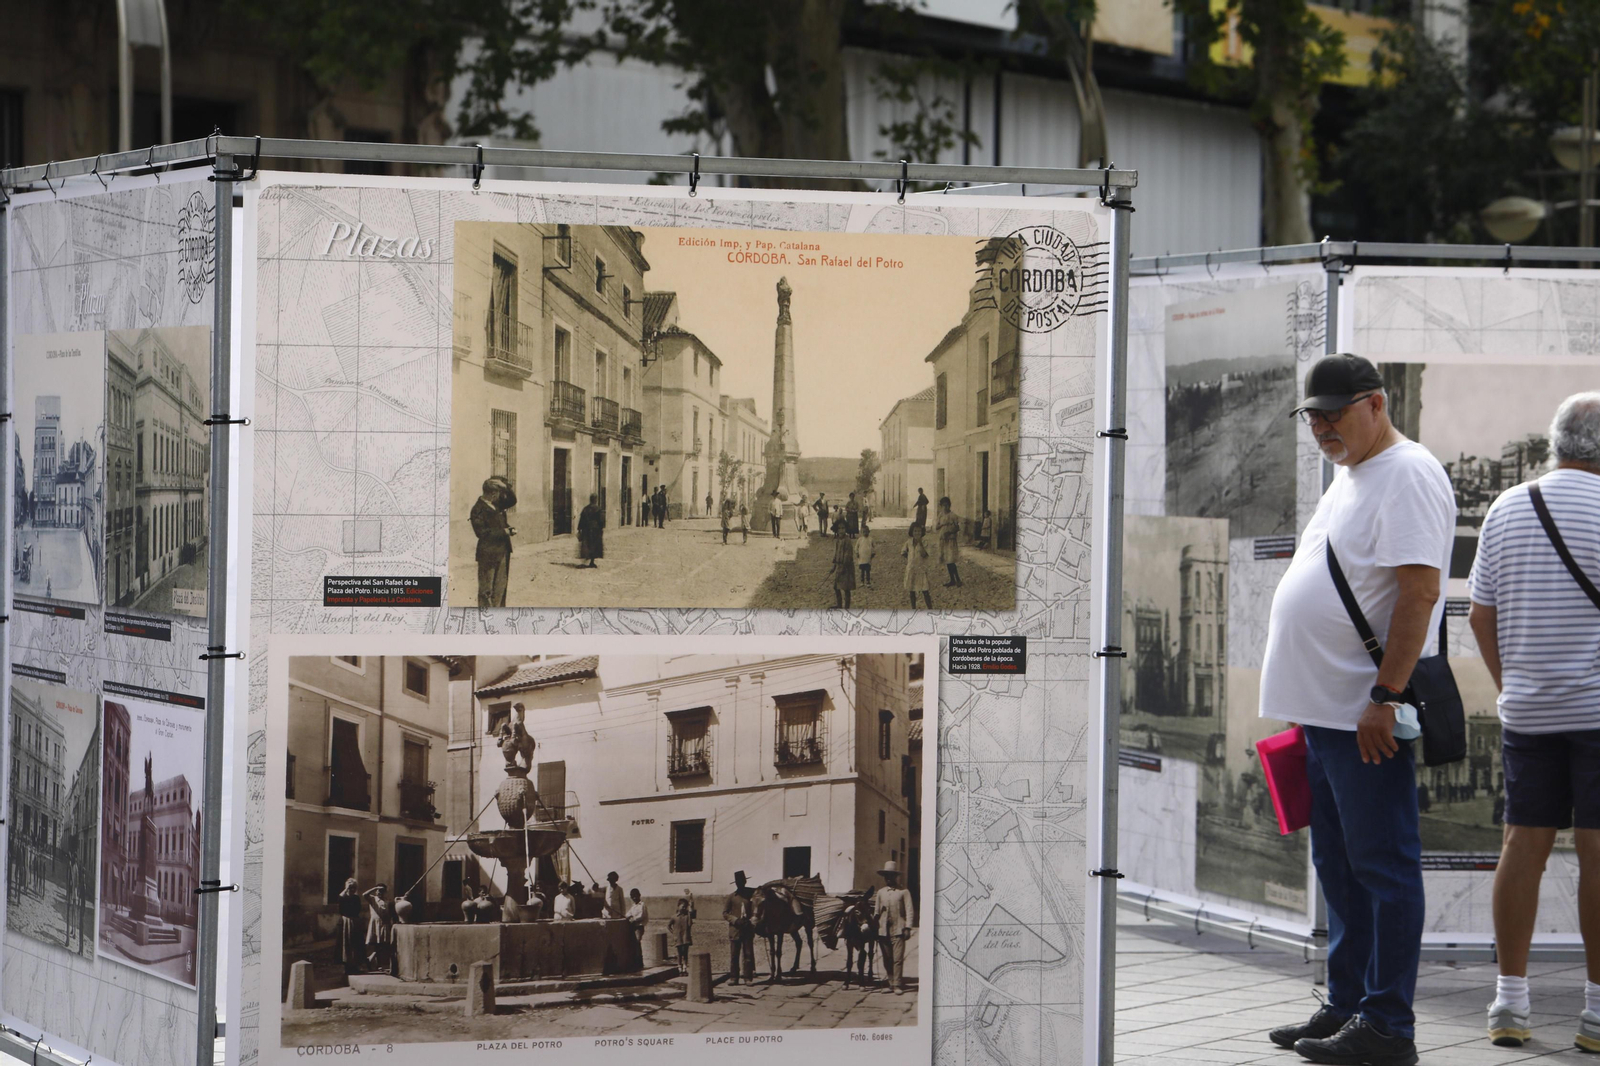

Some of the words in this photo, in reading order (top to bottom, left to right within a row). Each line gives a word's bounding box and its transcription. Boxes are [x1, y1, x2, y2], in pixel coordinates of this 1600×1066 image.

[318, 221, 438, 260] Plazas
[678, 236, 716, 248] Edición
[720, 238, 742, 250] Imp.
[746, 242, 752, 251] y
[755, 240, 776, 251] Pap.
[780, 241, 820, 251] Catalana
[1000, 233, 1029, 260] UNA
[1034, 229, 1076, 262] CIUDAD
[797, 254, 817, 266] San
[820, 255, 852, 267] Rafael
[856, 256, 872, 268] del
[876, 256, 904, 269] Potro
[1003, 299, 1022, 322] DE
[1026, 299, 1075, 328] POSTAL
[327, 578, 361, 586] Perspectiva
[327, 596, 354, 604] Imprenta
[706, 1036, 735, 1044] PLACE
[738, 1036, 750, 1044] DU
[753, 1035, 783, 1043] POTRO
[850, 1033, 869, 1041] Foto.
[477, 1042, 508, 1050] PLAZA
[510, 1042, 529, 1050] DEL
[532, 1041, 562, 1049] POTRO
[594, 1037, 634, 1047] POTRO'S
[637, 1037, 674, 1046] SQUARE
[387, 1044, 394, 1053] 8
